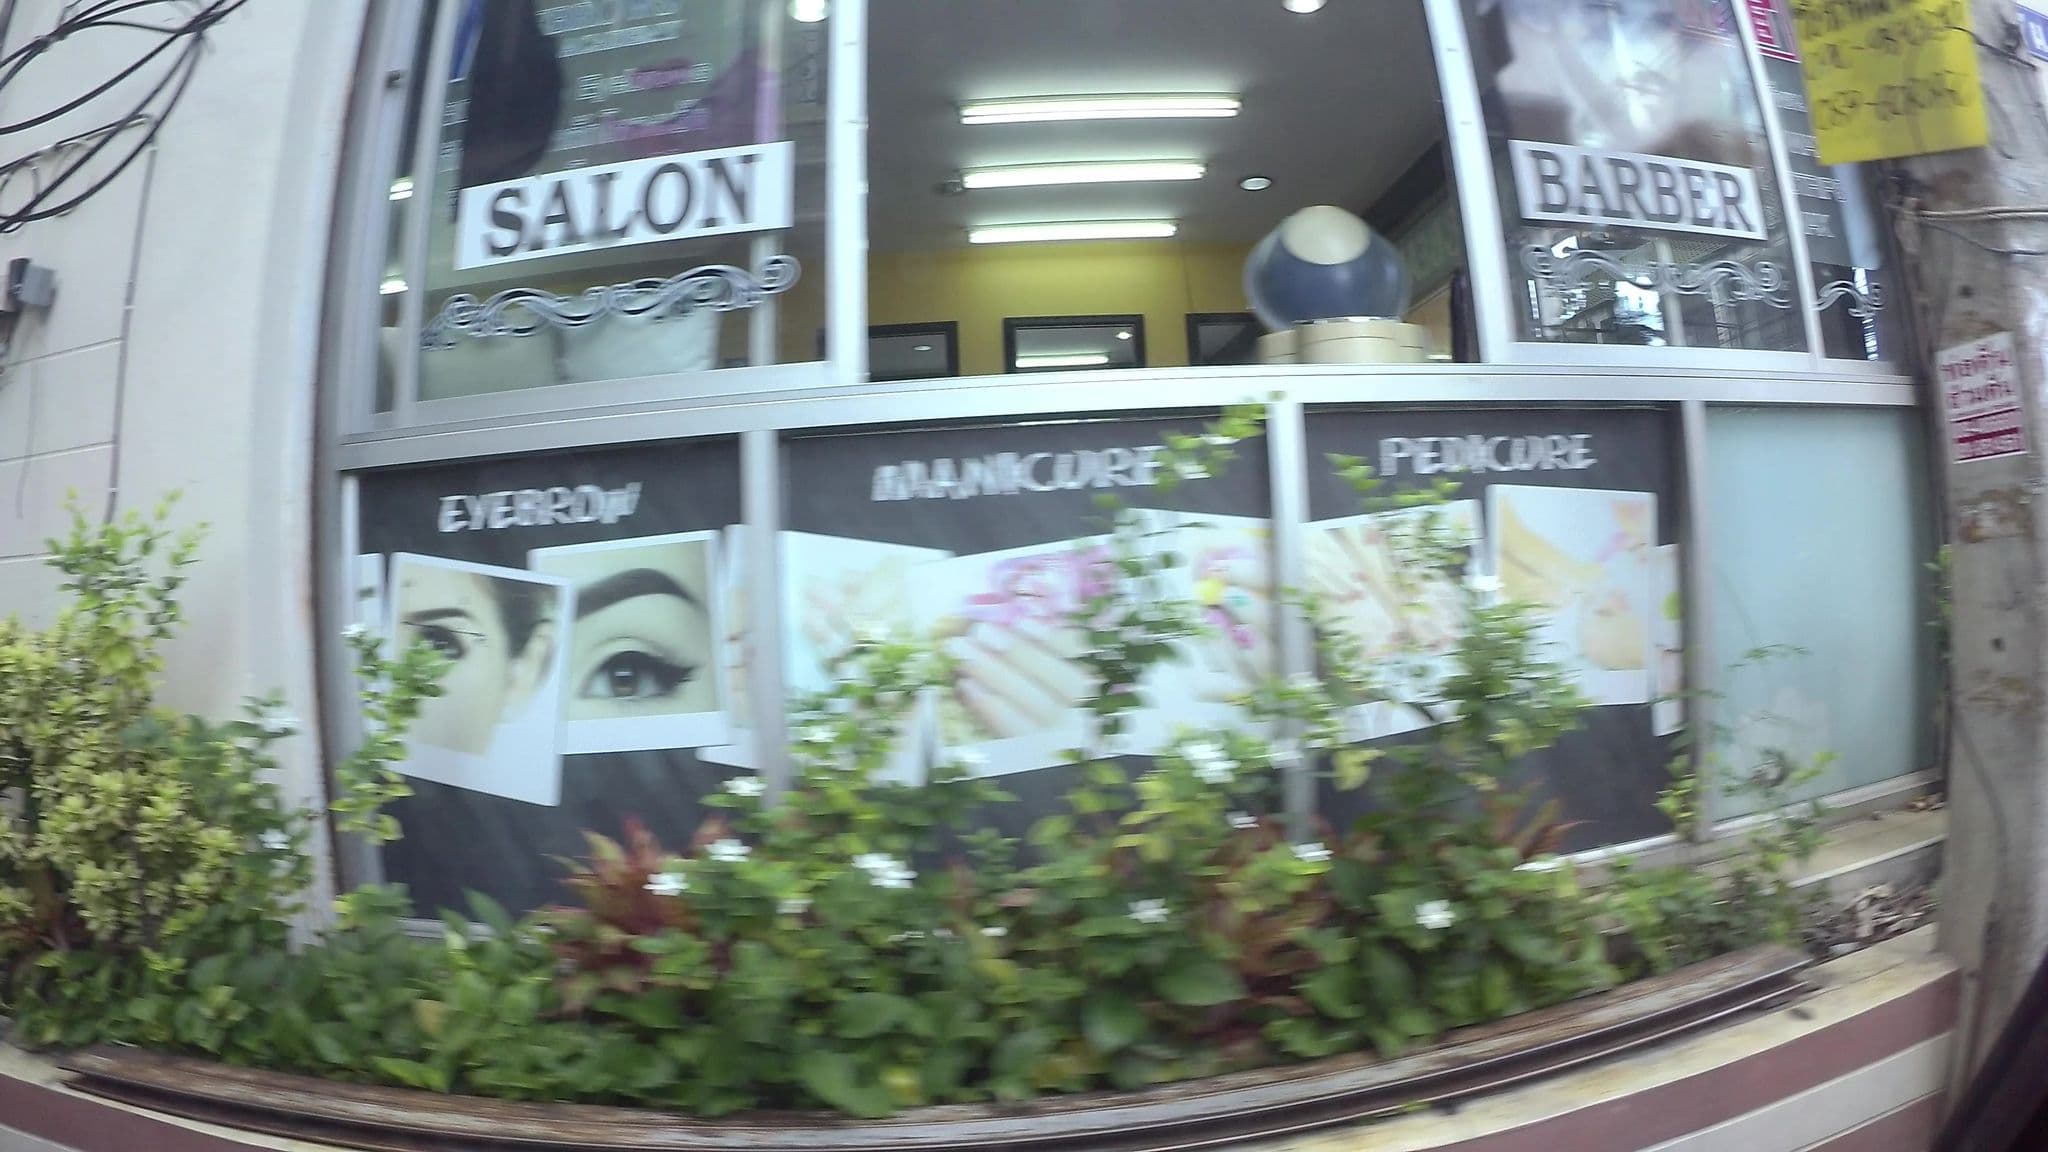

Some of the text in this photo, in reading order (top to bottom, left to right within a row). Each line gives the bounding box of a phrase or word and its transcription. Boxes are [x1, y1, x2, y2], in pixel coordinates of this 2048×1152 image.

[484, 153, 763, 257] SALON
[1527, 149, 1755, 233] BARBER
[1378, 433, 1598, 476] PEDICURE
[437, 481, 643, 533] EYEBROW
